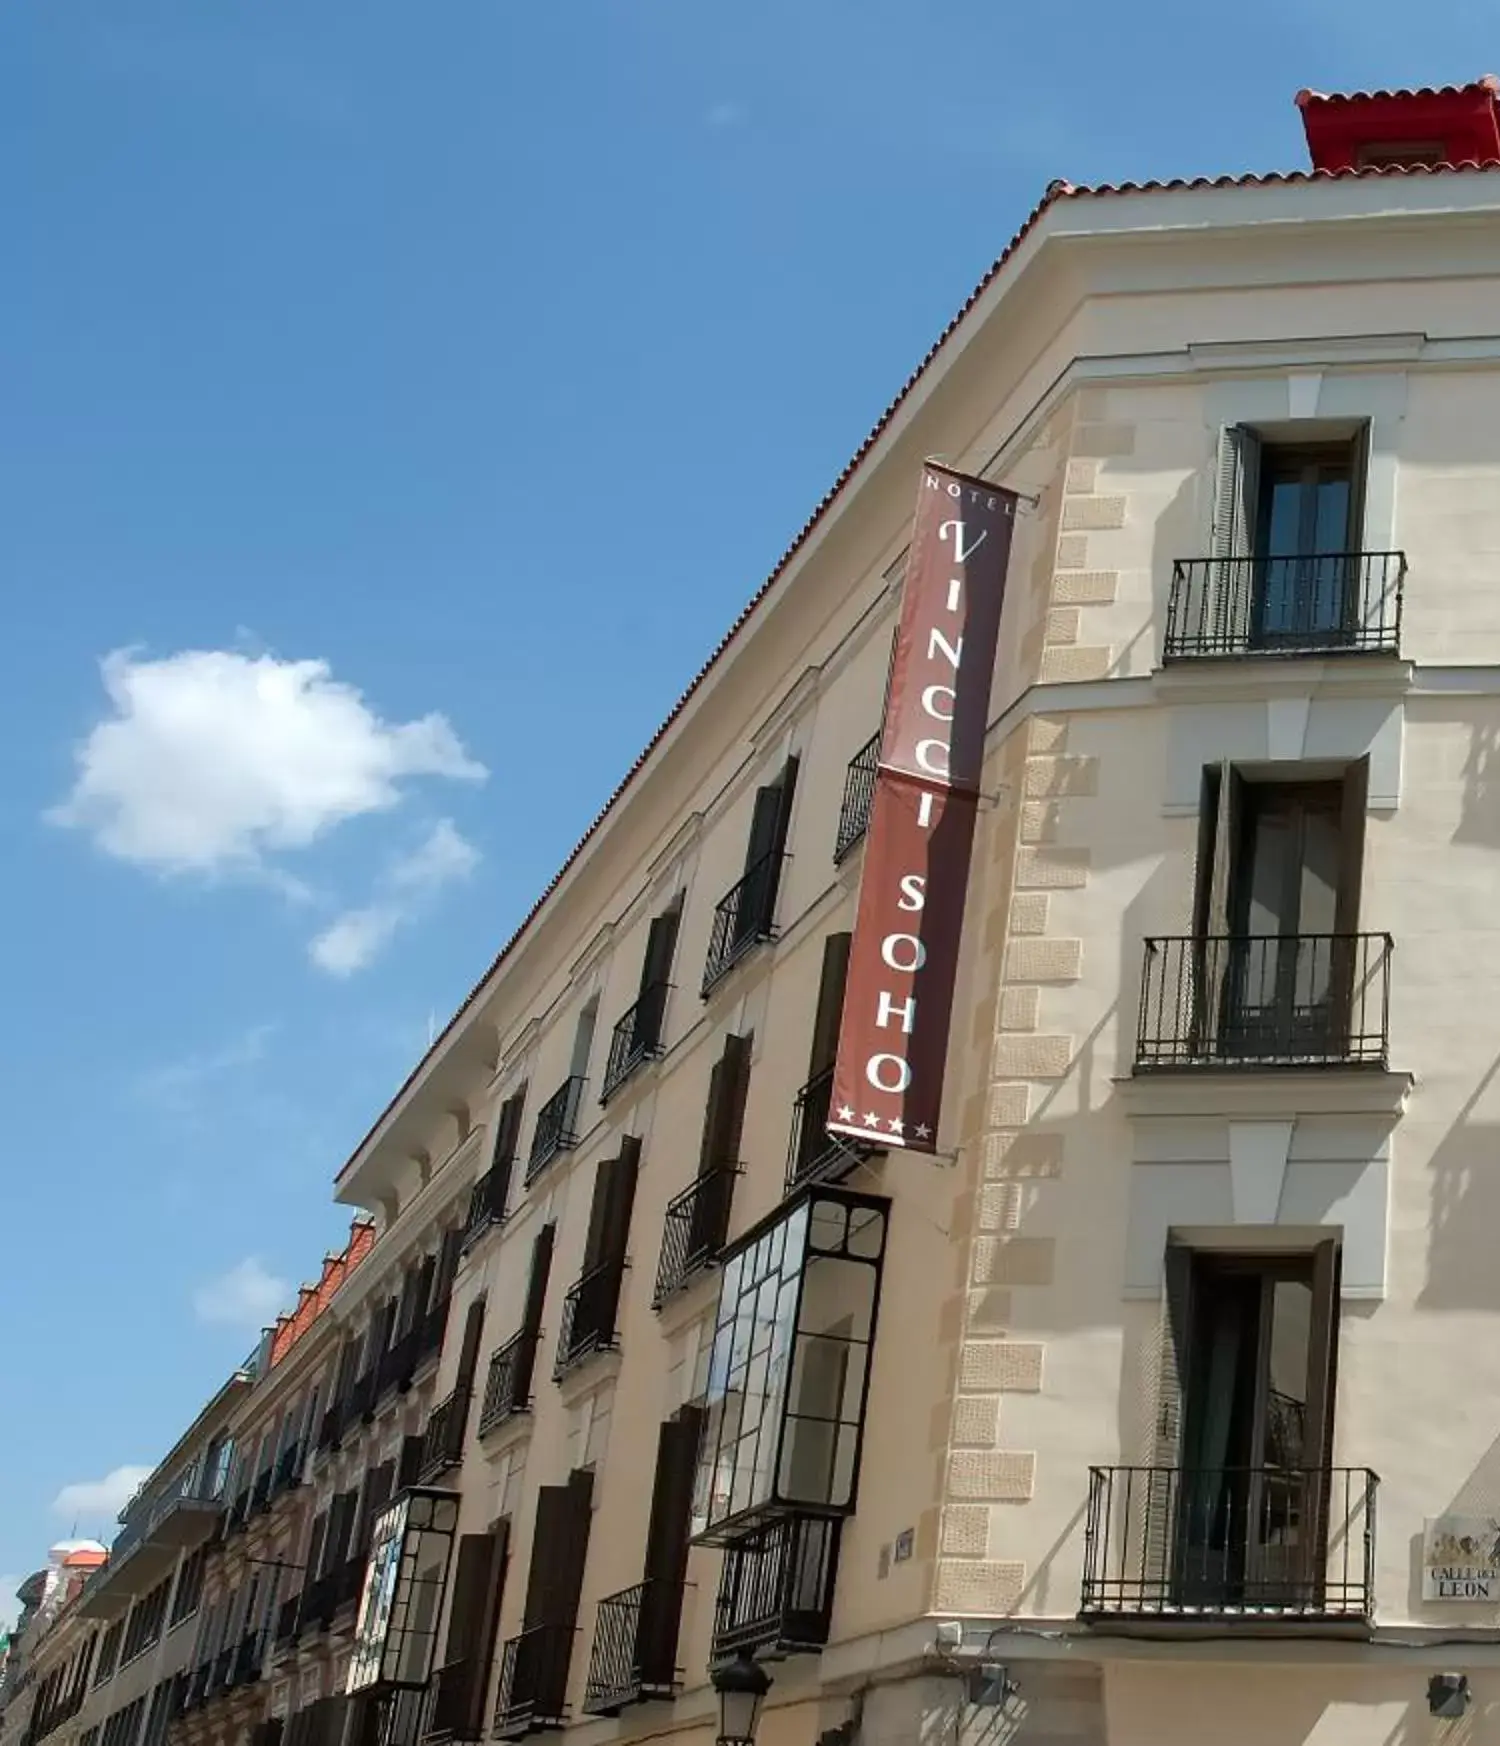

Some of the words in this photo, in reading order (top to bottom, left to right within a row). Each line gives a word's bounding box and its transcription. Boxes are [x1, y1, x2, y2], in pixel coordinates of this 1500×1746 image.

[925, 474, 1014, 515] HOTEL
[915, 520, 987, 828] VINCCI
[865, 874, 927, 1093] SOHO
[1431, 1567, 1476, 1581] CALLE
